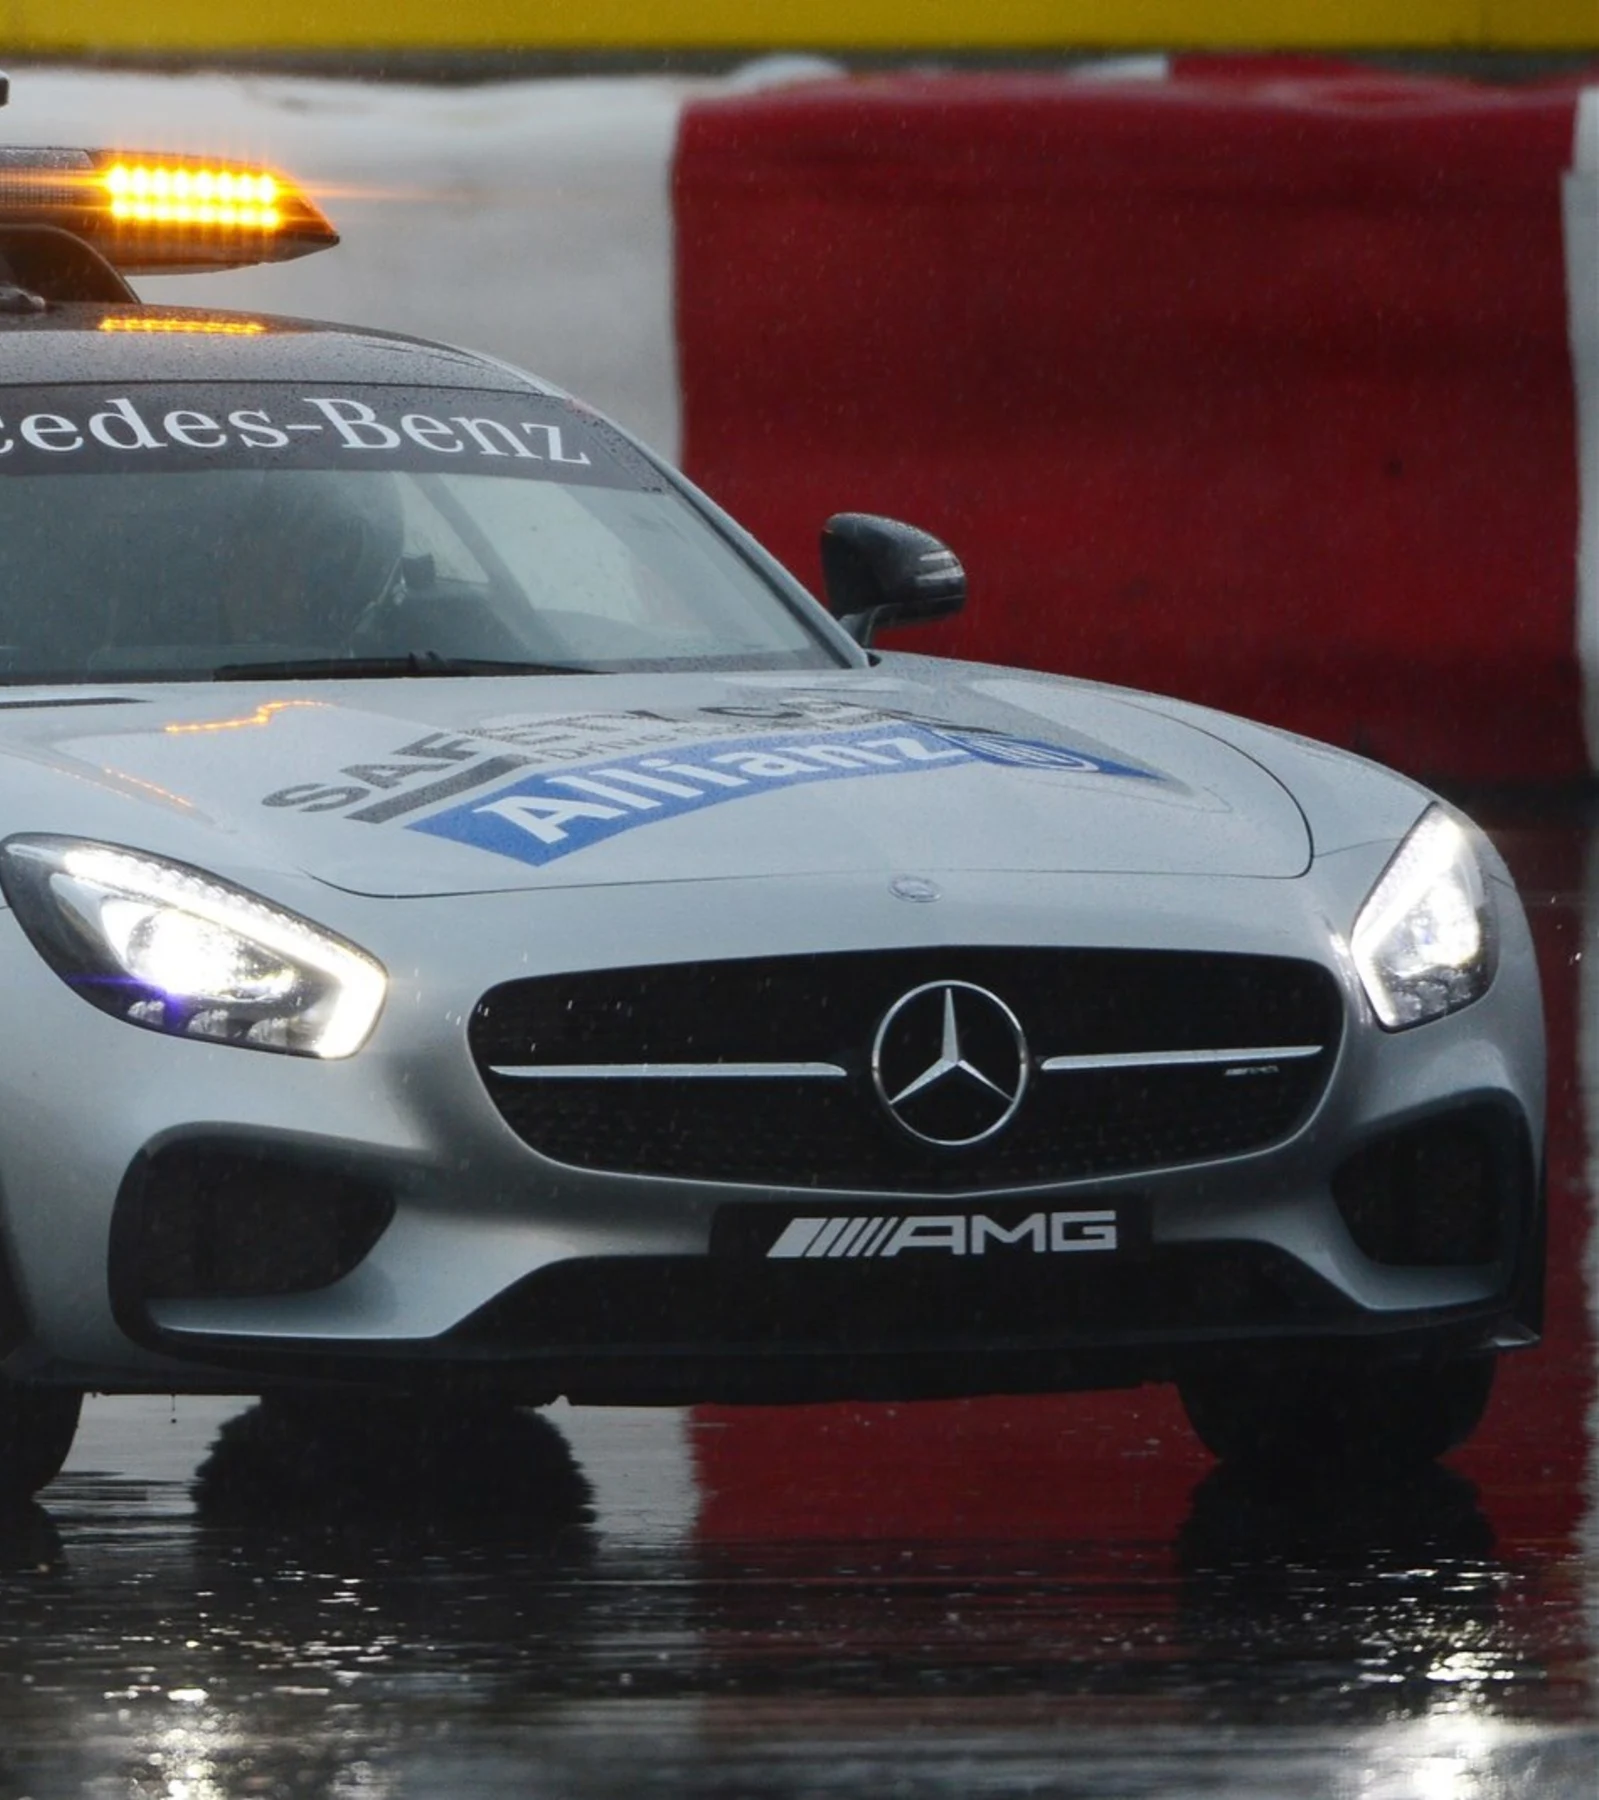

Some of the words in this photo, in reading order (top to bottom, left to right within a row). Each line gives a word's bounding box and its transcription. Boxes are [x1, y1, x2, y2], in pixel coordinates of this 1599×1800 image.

[262, 709, 691, 813] SAFETY
[472, 735, 973, 844] Allianz
[880, 1209, 1118, 1259] AMG
